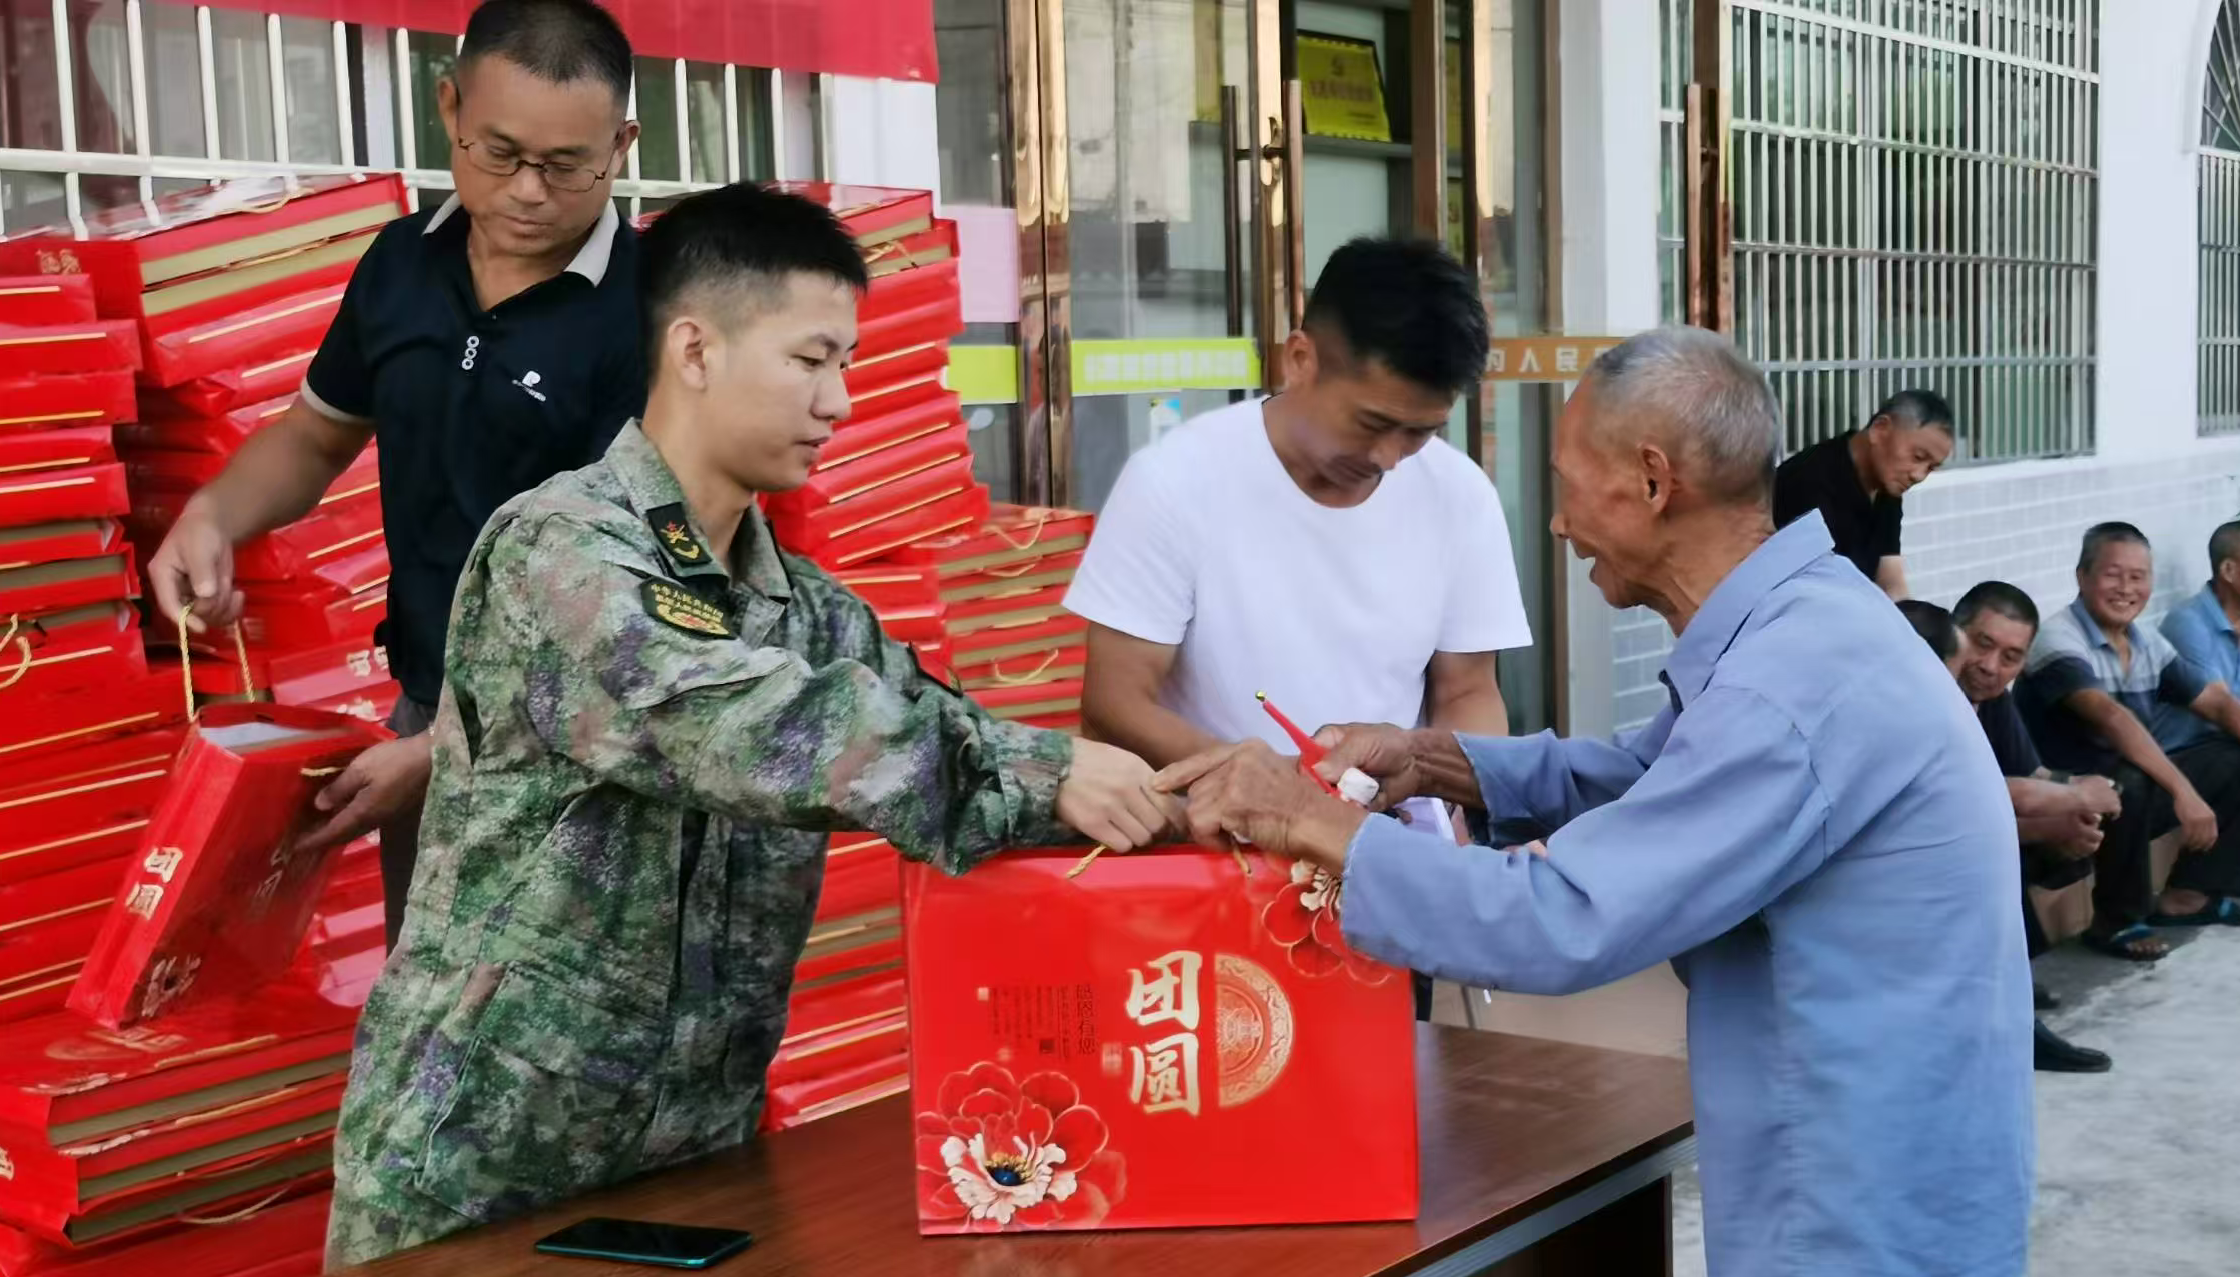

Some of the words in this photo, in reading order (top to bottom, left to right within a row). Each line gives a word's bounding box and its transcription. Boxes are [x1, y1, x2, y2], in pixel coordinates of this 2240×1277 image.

[1485, 347, 1613, 372] 的人民
[1126, 950, 1202, 1116] 团圆
